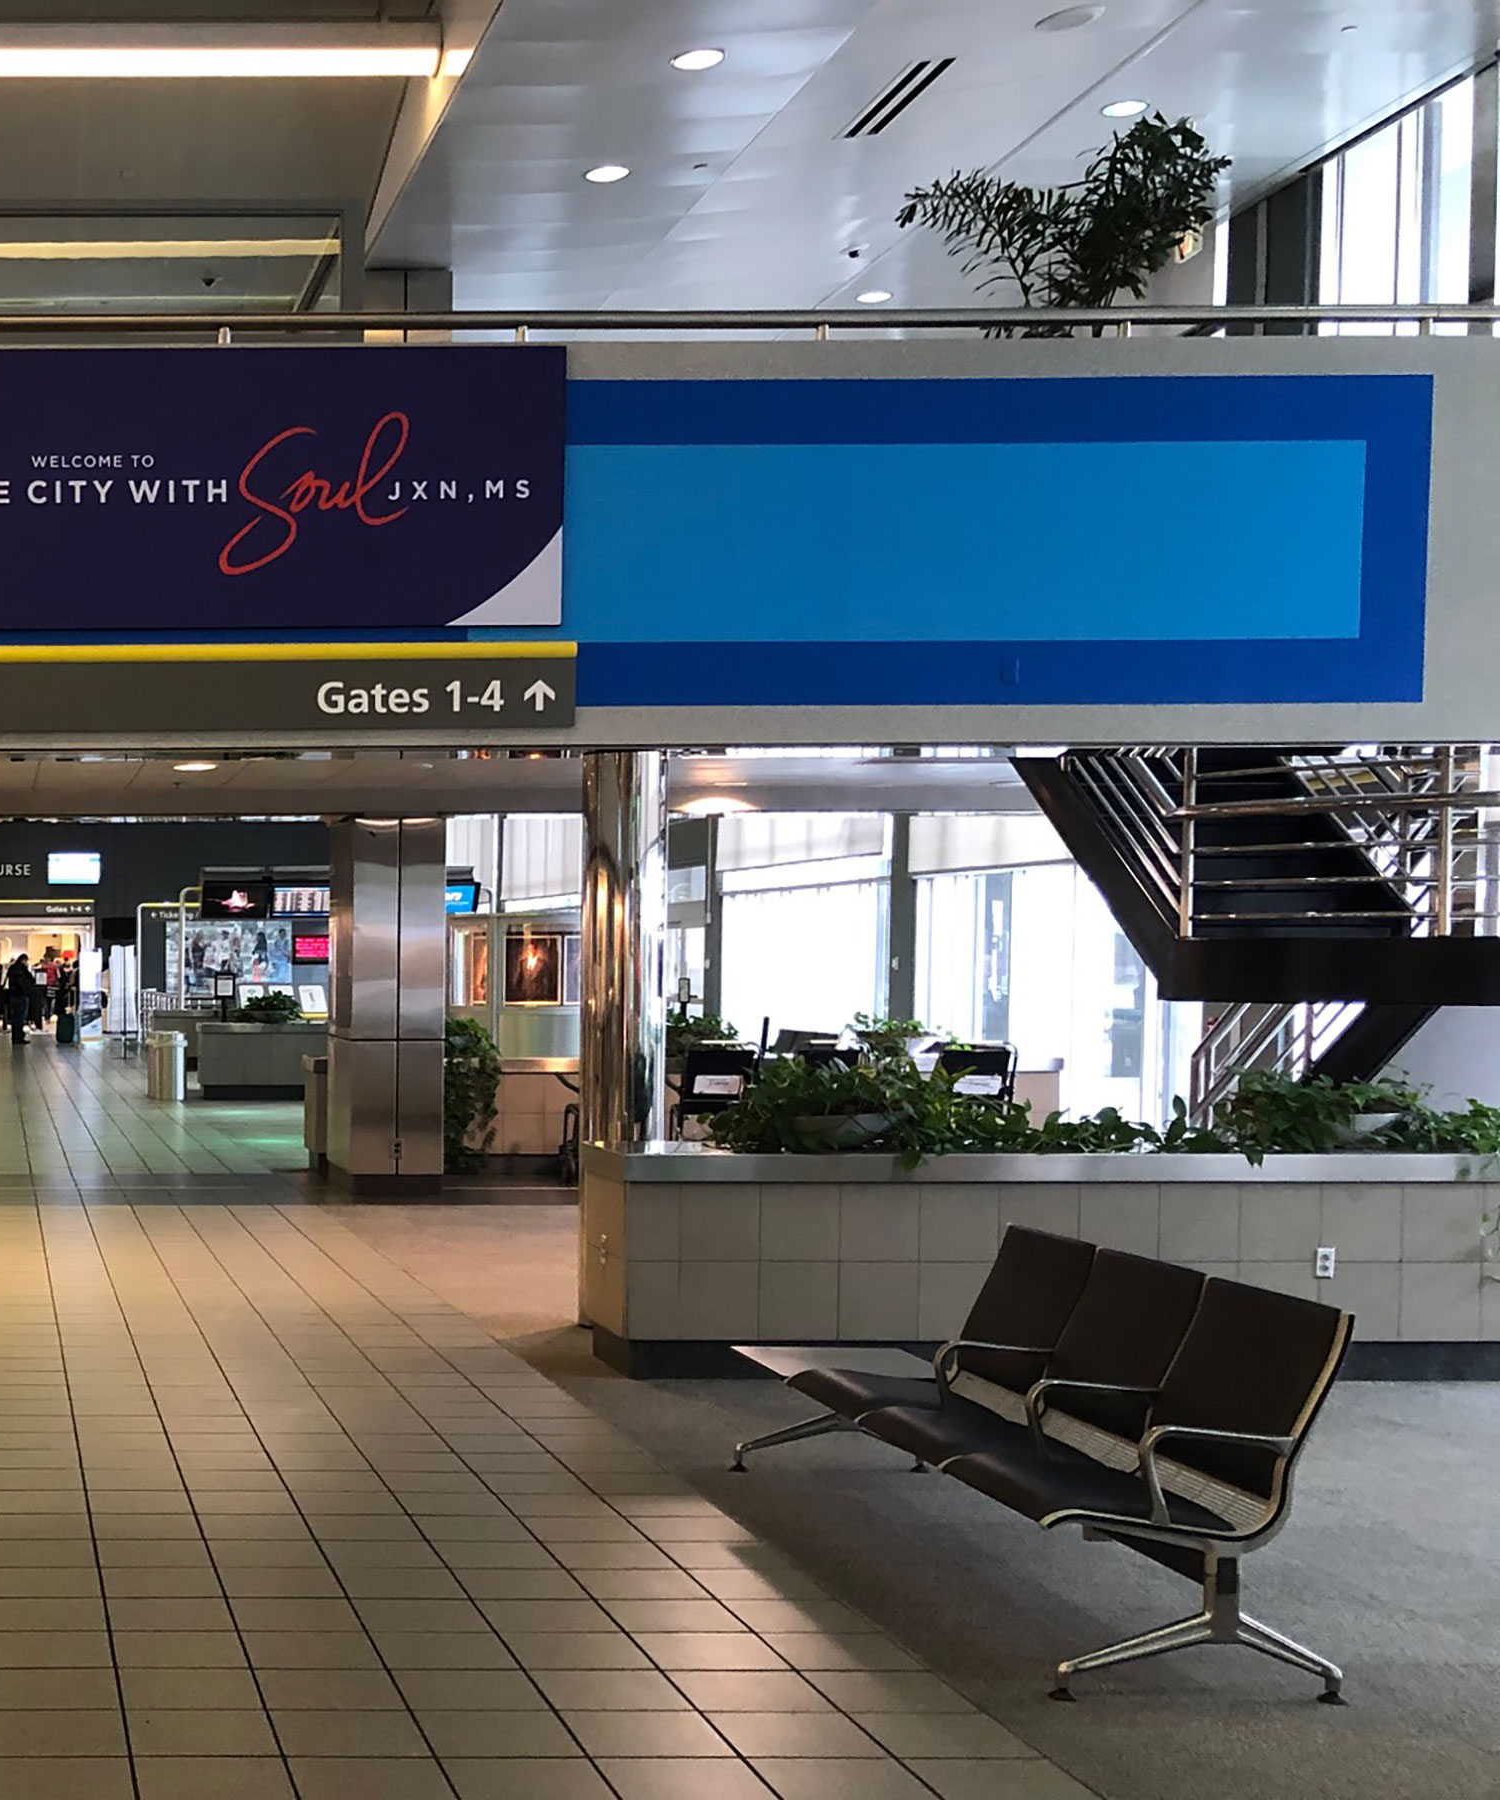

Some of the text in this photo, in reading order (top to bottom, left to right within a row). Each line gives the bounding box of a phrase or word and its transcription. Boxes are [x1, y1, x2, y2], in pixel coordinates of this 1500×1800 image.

[30, 454, 155, 469] WELCOME TO
[27, 479, 113, 504] CITY
[128, 478, 228, 504] WITH
[218, 410, 410, 576] Soul
[316, 679, 505, 714] Gates 1-4
